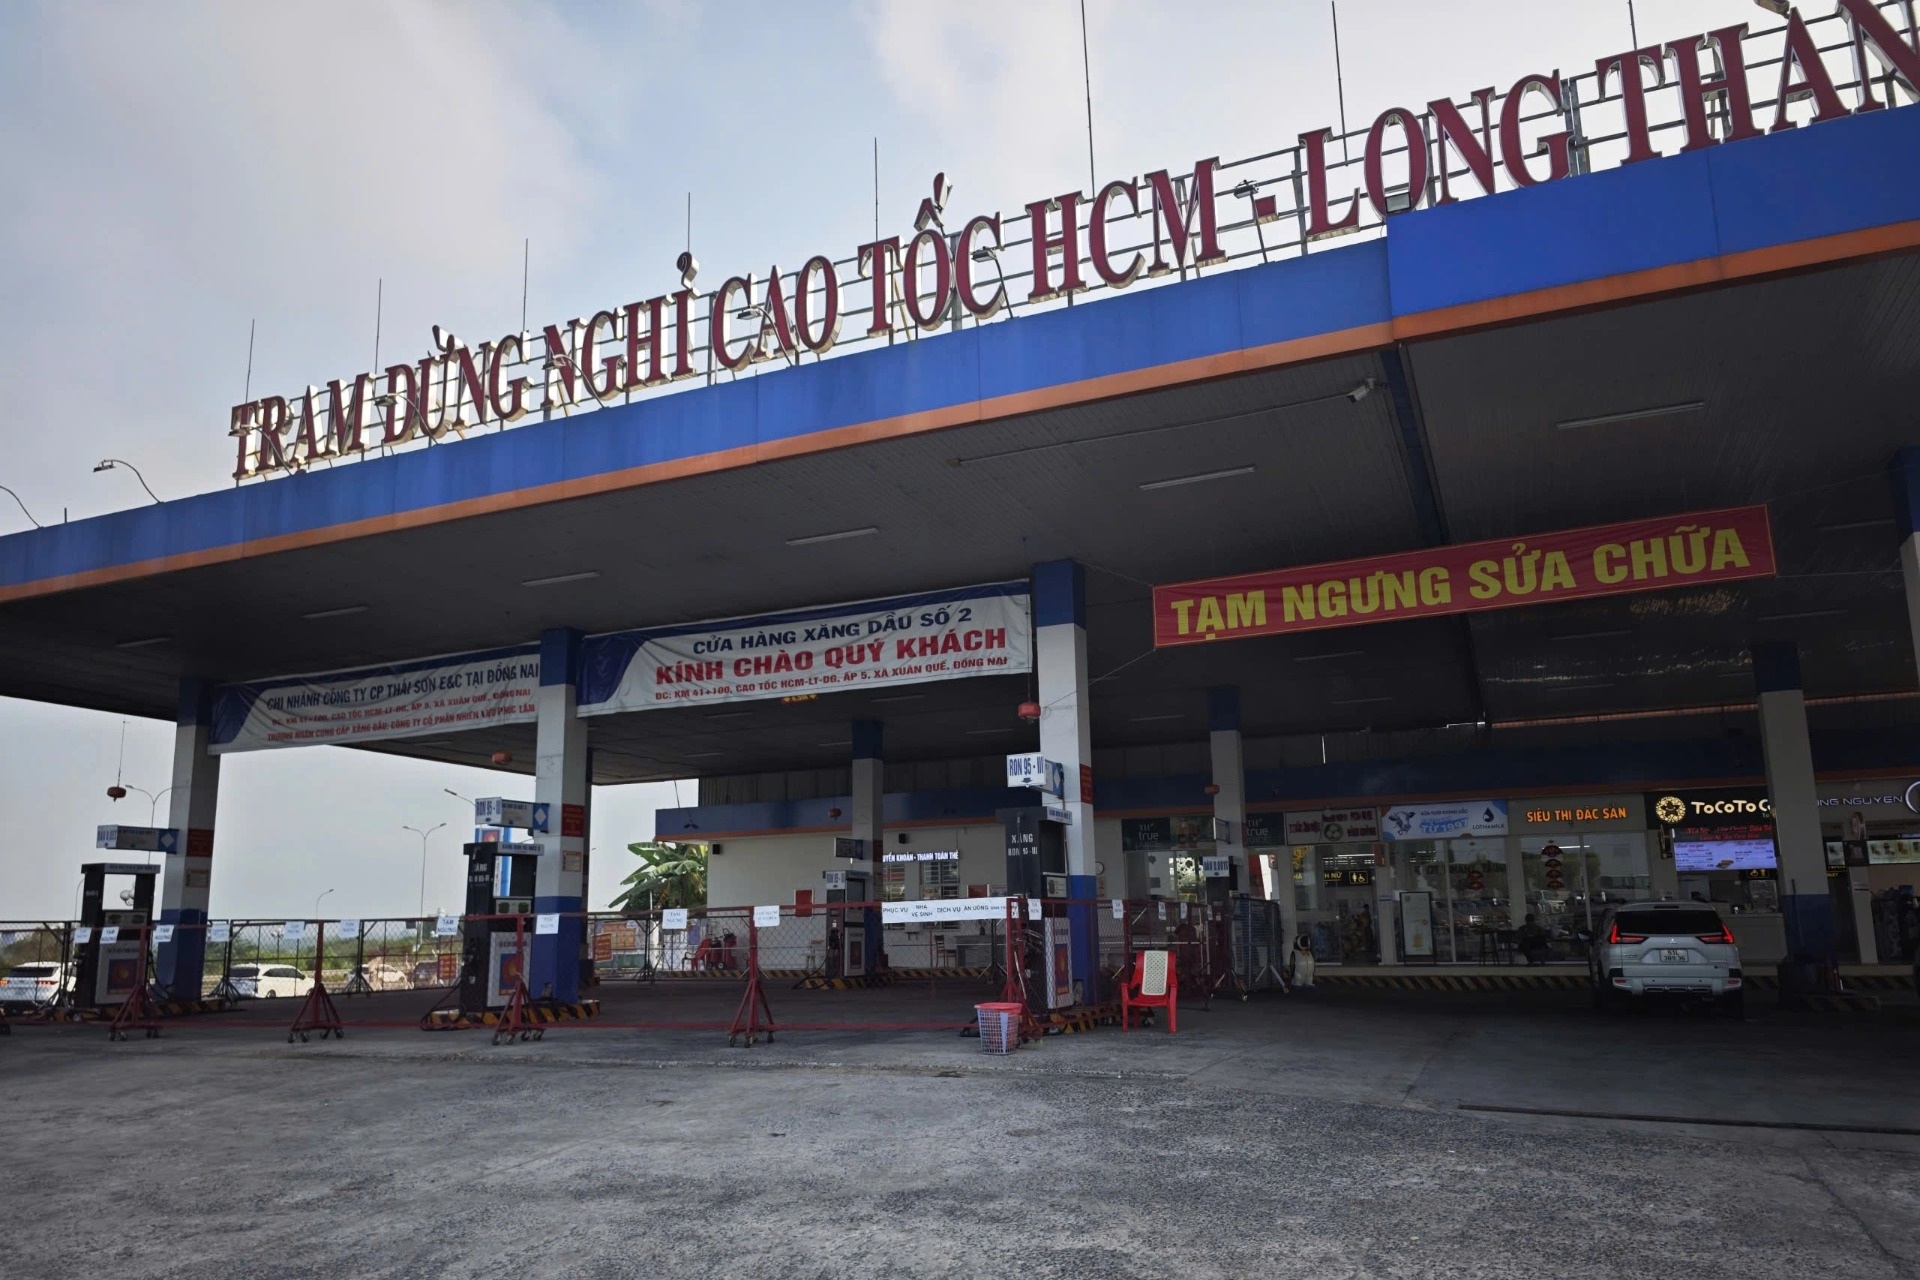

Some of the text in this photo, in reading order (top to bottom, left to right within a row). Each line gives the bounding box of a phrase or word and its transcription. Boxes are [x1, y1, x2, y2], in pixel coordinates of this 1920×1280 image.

[385, 325, 534, 446] DỪNG
[543, 251, 700, 408] NGHỈ
[711, 255, 844, 372] CAO
[857, 172, 1004, 337] TỐC
[1025, 157, 1227, 303] HCM
[1256, 195, 1278, 225] -
[1299, 69, 1573, 241] LONG
[1171, 524, 1751, 640] TẠM NGƯNG SỬA CHỮA
[693, 605, 972, 655] CỬA HÀNG XĂNG DẦU SỐ 2
[656, 628, 1006, 685] KÍNH CHÀO QUÝ KHÁCH
[675, 689, 690, 698] KM
[736, 683, 755, 693] CAO
[759, 679, 777, 690] TỐC
[987, 657, 1008, 667] NAI
[267, 661, 539, 711] CHI NHÁNH CÔNG TY CP THÁI SƠN E&C TẠI ĐỒNG NAI
[1010, 757, 1022, 776] RON
[1024, 757, 1031, 776] 95
[1843, 795, 1903, 805] NGUYEN
[1138, 832, 1159, 840] true
